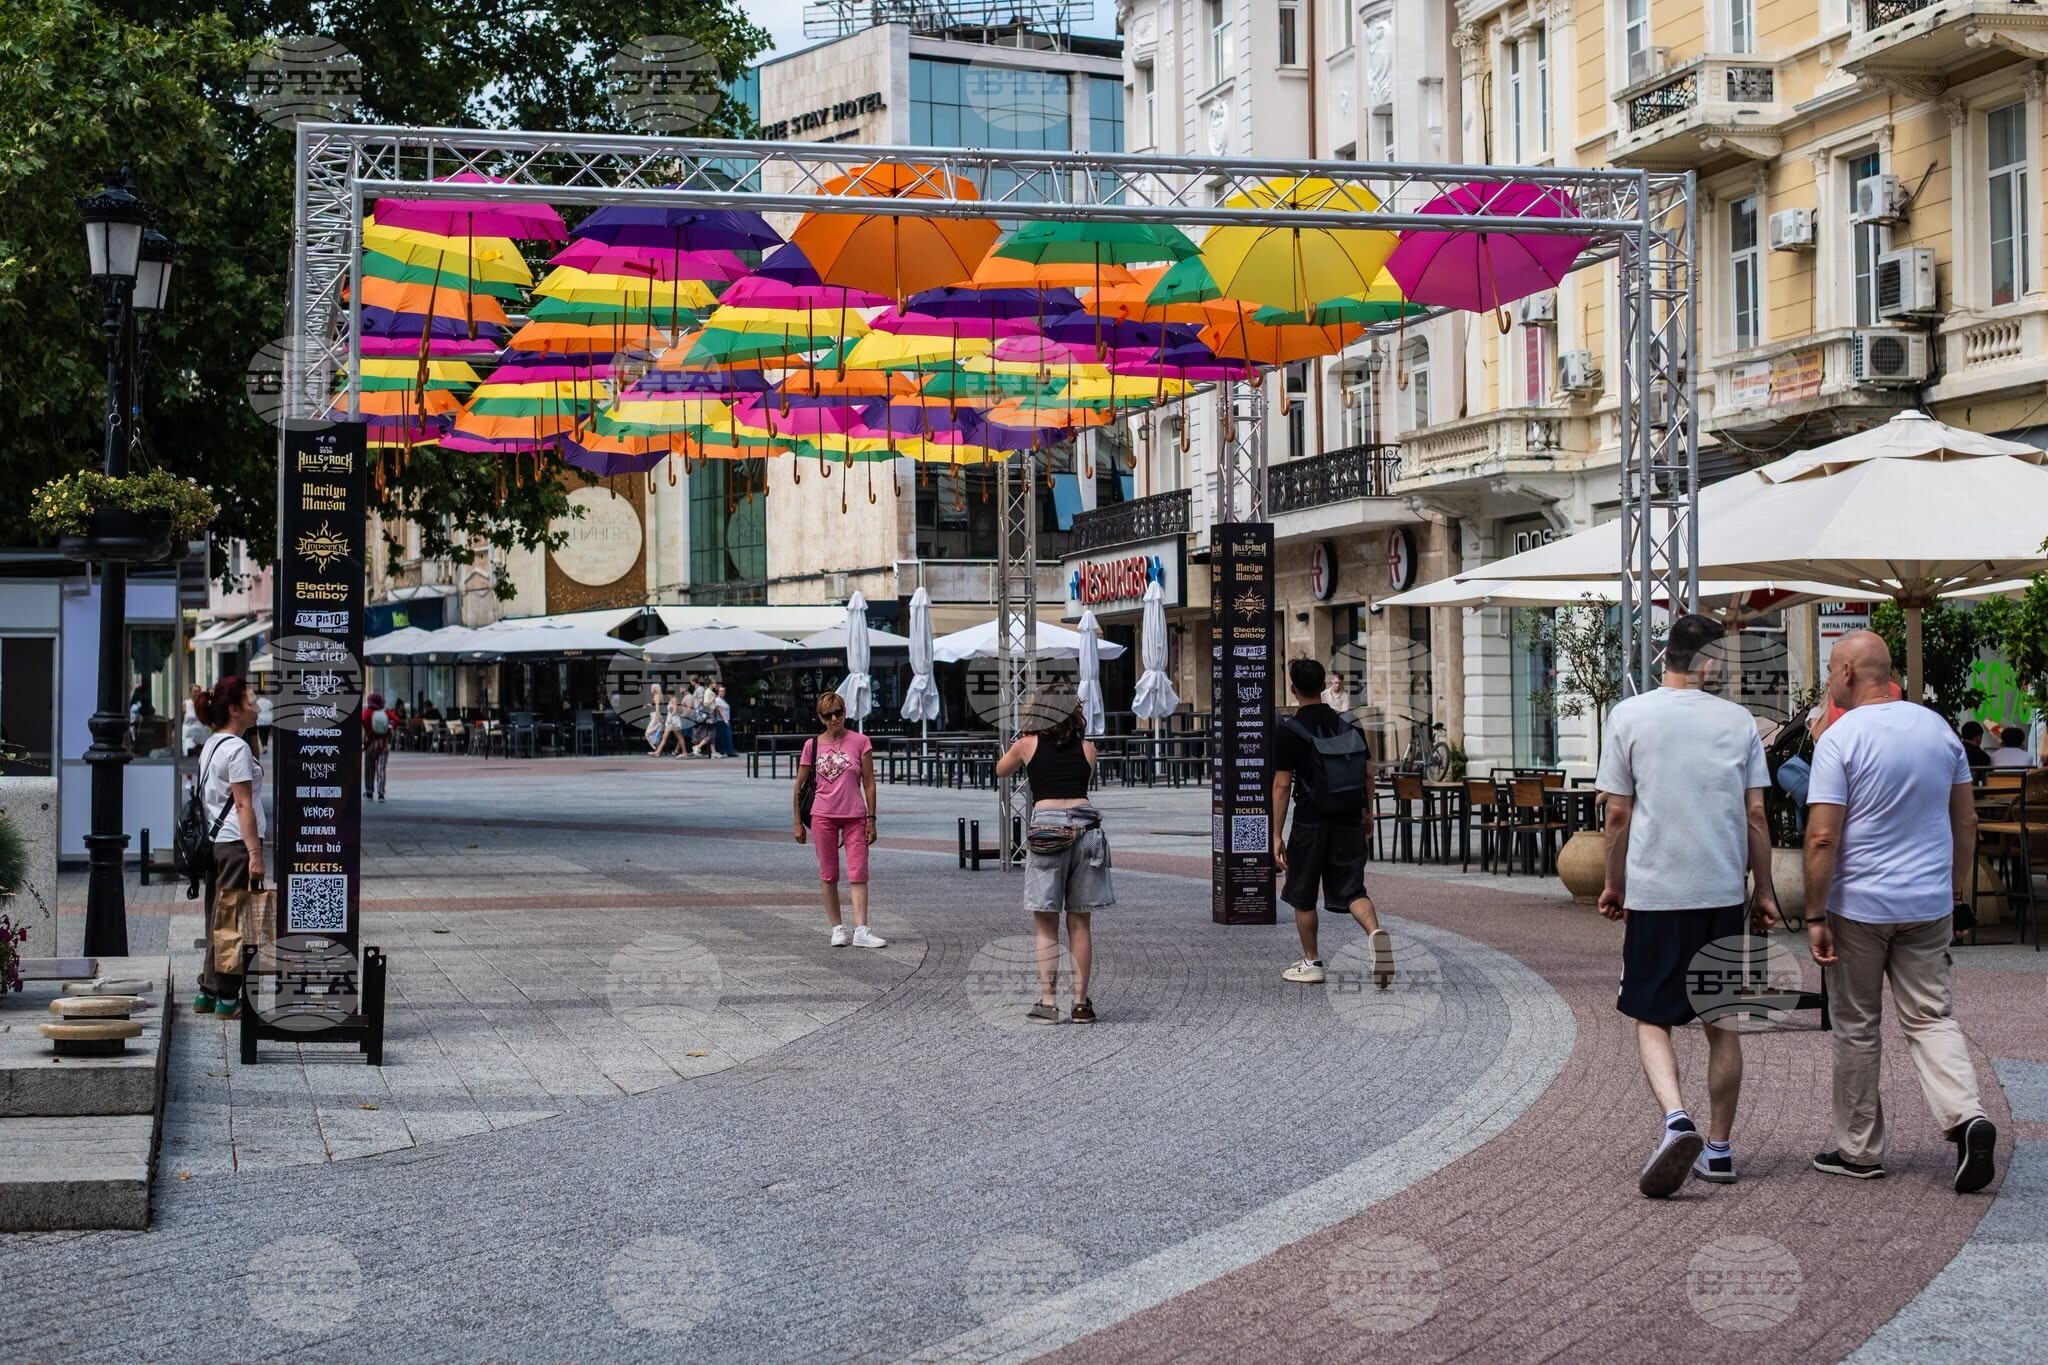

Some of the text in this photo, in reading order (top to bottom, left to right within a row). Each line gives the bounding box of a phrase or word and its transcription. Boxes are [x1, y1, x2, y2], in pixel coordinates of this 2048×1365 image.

[791, 107, 829, 135] STAY
[832, 92, 887, 122] HOTEL
[298, 450, 324, 472] HILLS
[329, 452, 353, 474] ROCK
[302, 483, 346, 499] Marilyn
[302, 497, 346, 511] Manson
[1235, 563, 1263, 573] Marilyn
[1078, 555, 1148, 605] HESBURGER
[296, 582, 349, 591] Electric
[296, 591, 348, 601] Callboy
[298, 727, 342, 738] SKINDRED
[303, 806, 335, 819] VENDED
[296, 841, 323, 853] karen
[293, 862, 343, 872] TICKETS:
[305, 940, 329, 948] POWER
